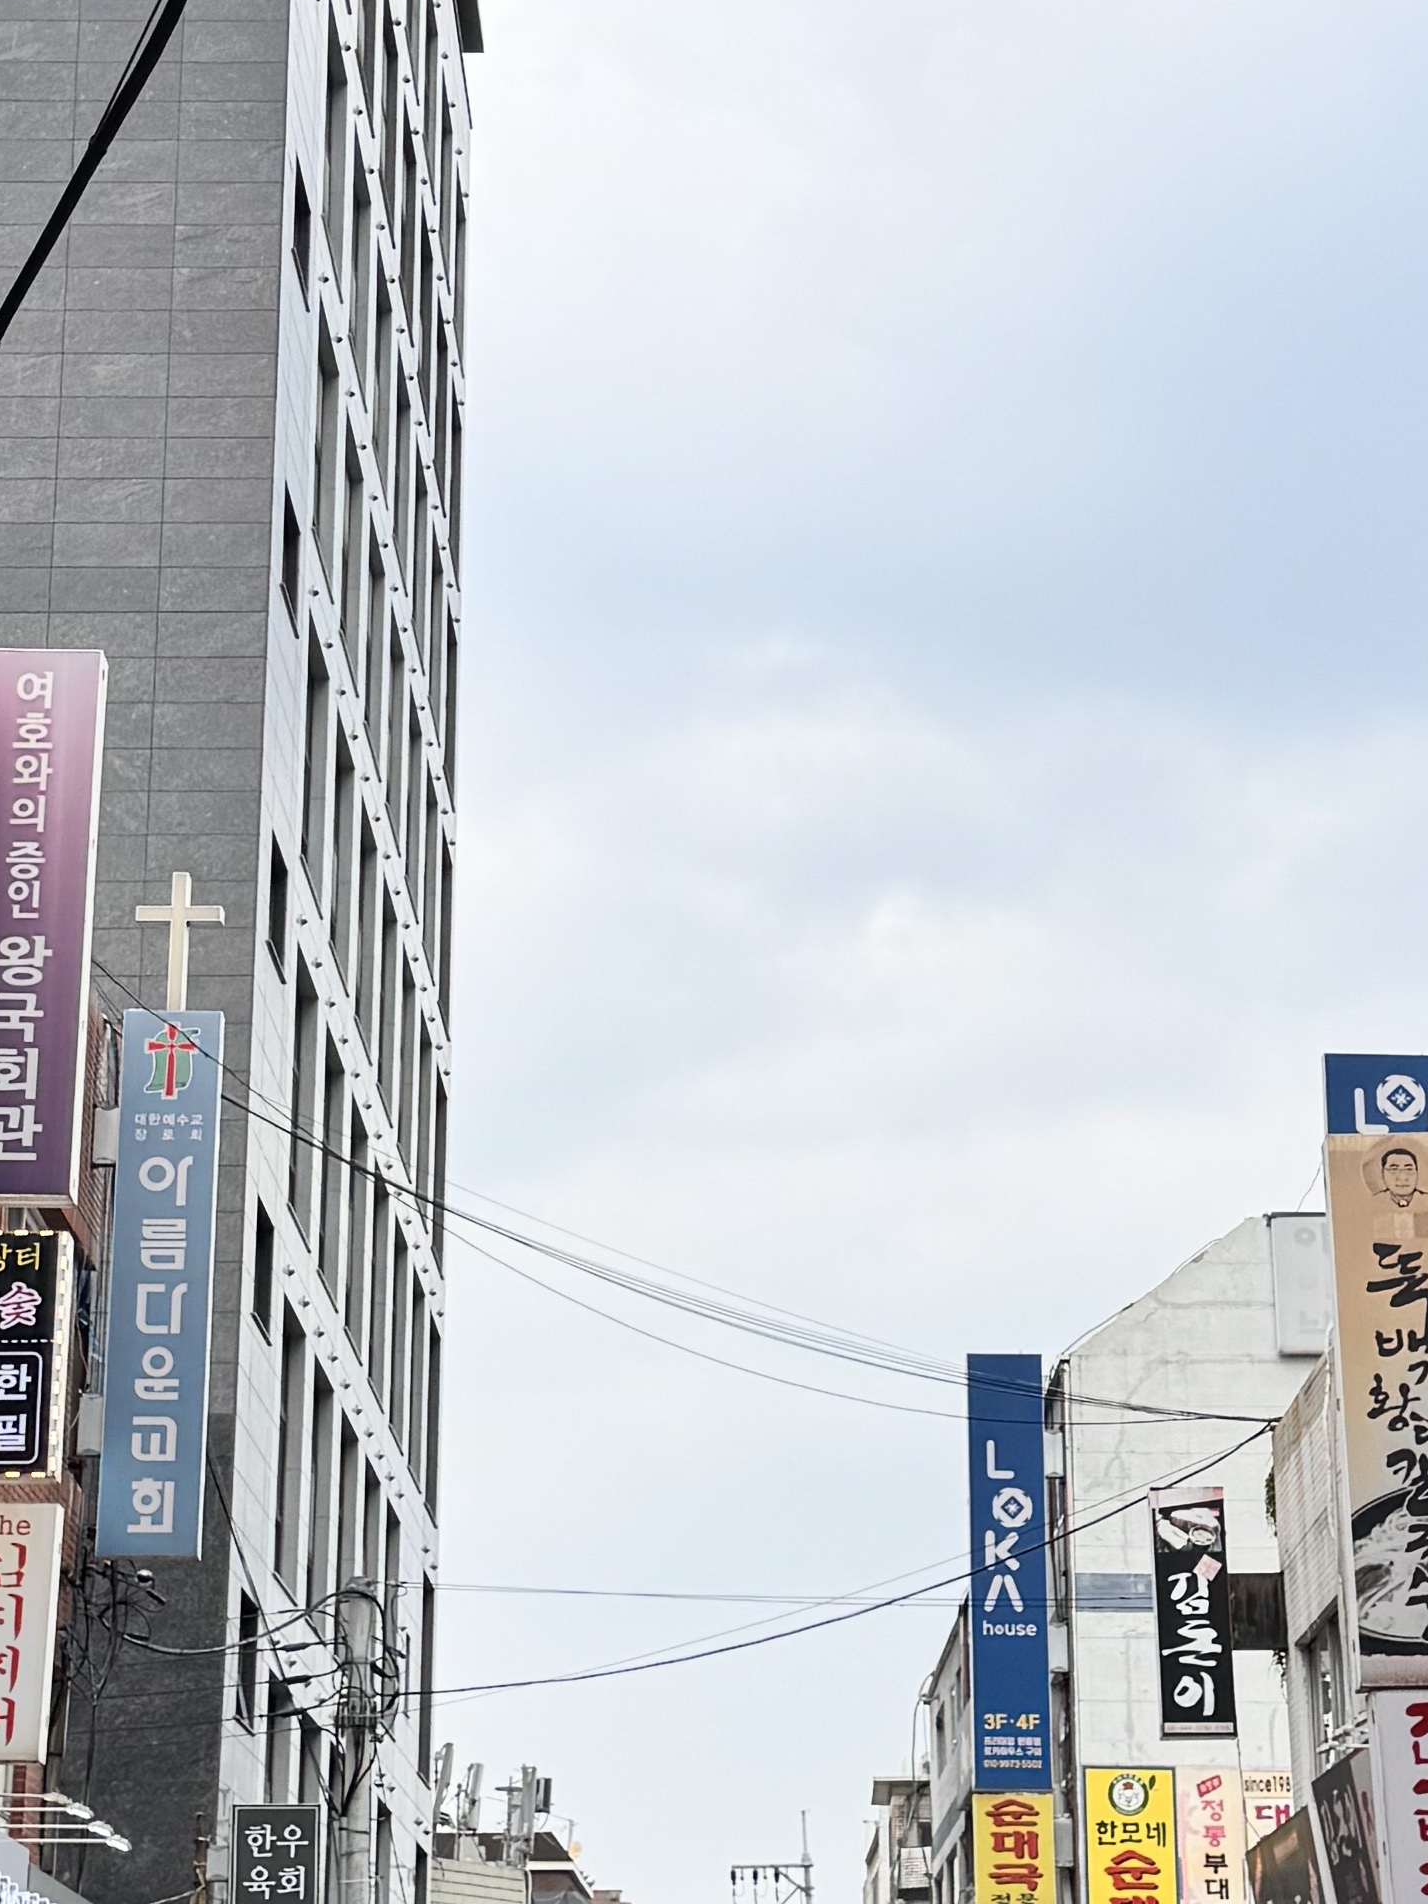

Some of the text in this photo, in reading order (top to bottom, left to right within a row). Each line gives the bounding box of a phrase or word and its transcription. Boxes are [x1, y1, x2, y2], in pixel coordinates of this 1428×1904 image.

[9, 671, 54, 833] 여호와의
[5, 841, 46, 920] 증인
[127, 1155, 193, 1534] 아름다운교회
[982, 1621, 1038, 1637] house
[244, 1826, 309, 1858] 한우
[986, 1800, 1044, 1891] 순대국
[1096, 1820, 1166, 1847] 한모네
[243, 1867, 306, 1900] 육회
[991, 1893, 1040, 1904] 전문
